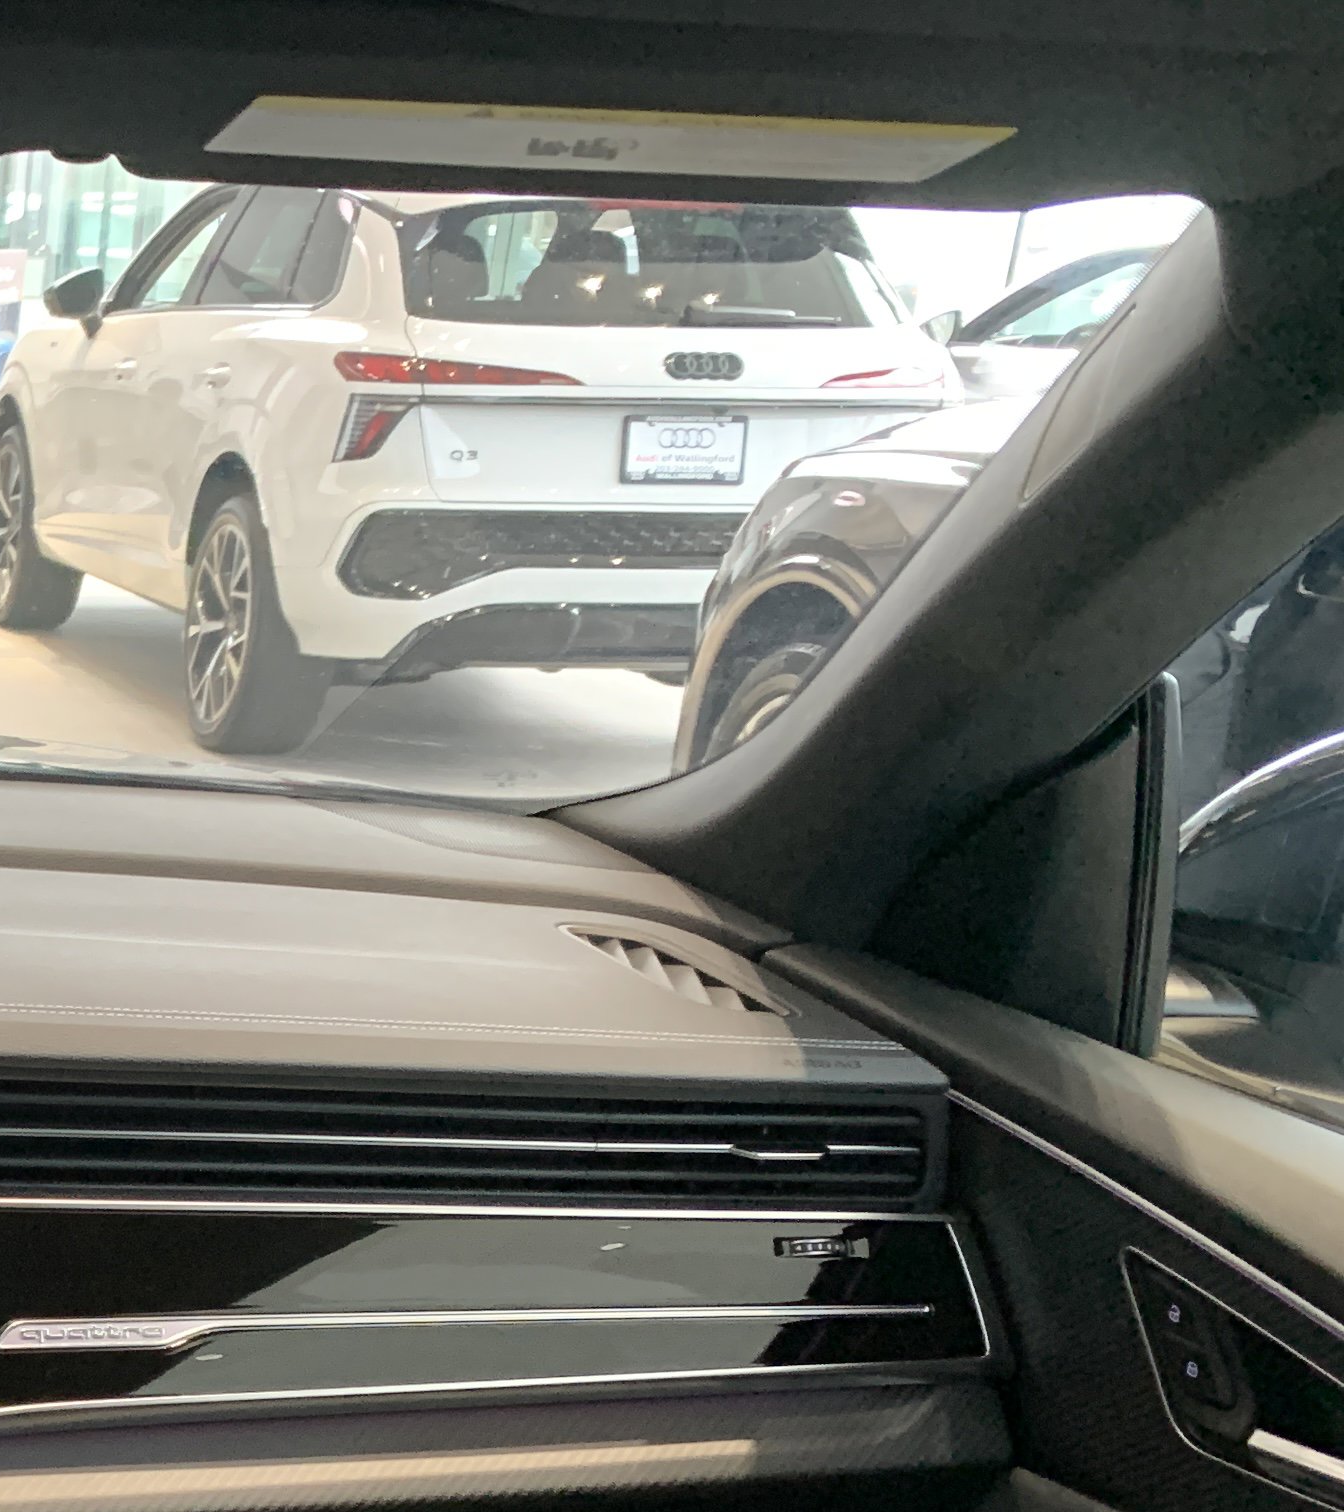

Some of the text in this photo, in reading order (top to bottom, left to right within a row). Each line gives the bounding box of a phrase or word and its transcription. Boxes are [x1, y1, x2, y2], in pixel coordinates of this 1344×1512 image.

[450, 449, 479, 461] Q3
[662, 454, 673, 462] of
[674, 454, 736, 464] Wallingford
[20, 1325, 166, 1343] quattro
